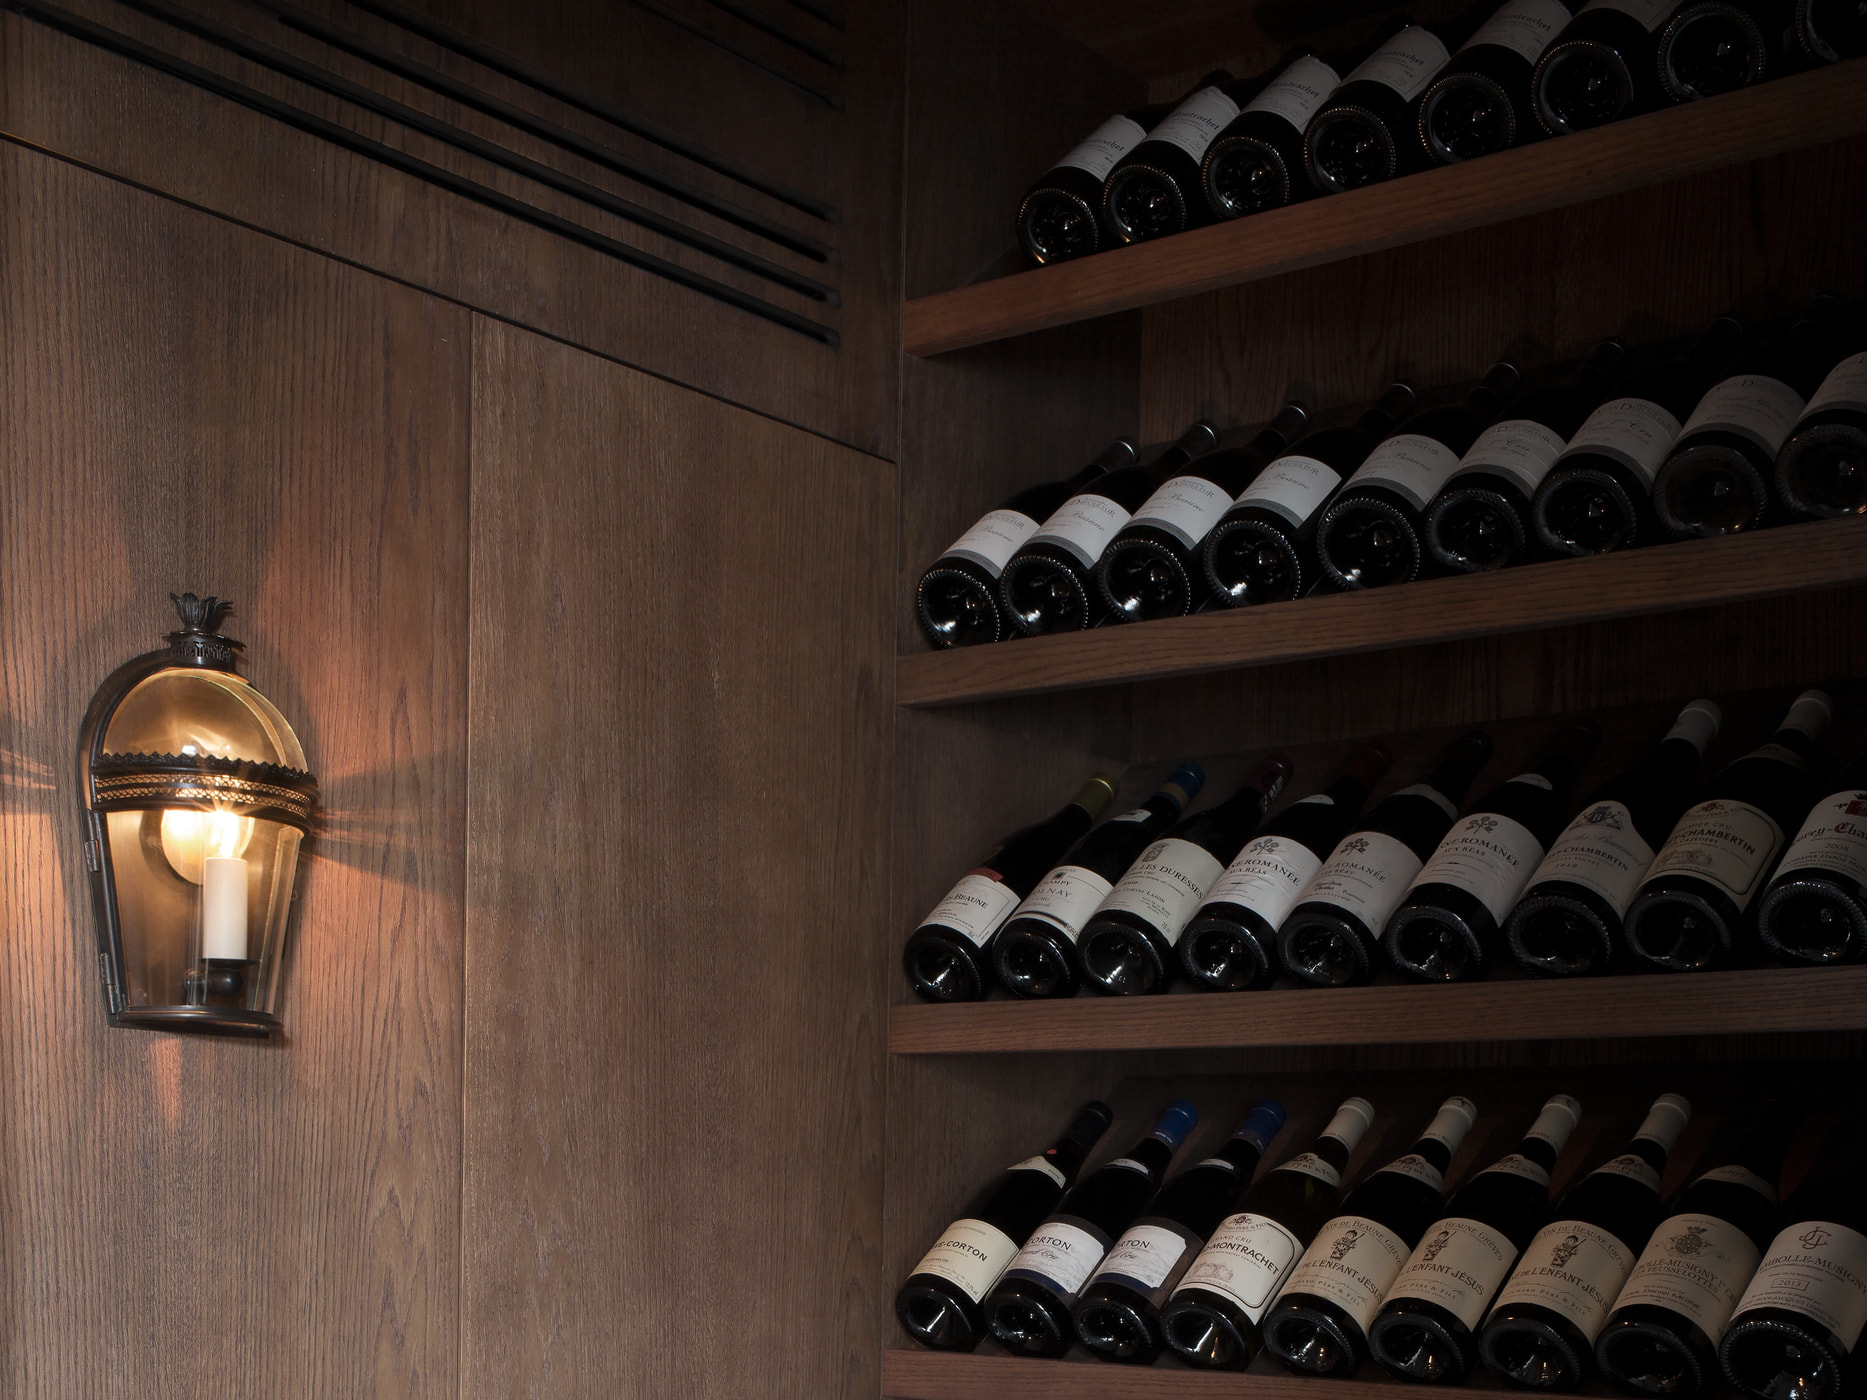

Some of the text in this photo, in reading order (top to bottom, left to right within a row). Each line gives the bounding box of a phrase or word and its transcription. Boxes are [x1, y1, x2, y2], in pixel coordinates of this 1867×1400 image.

[1158, 863, 1206, 901] DURESSES
[1311, 1258, 1361, 1280] L'ENFANT
[1530, 1265, 1585, 1288] L'ENFANT
[1450, 1269, 1486, 1298] JÉSUS
[1776, 1278, 1803, 1289] 2013
